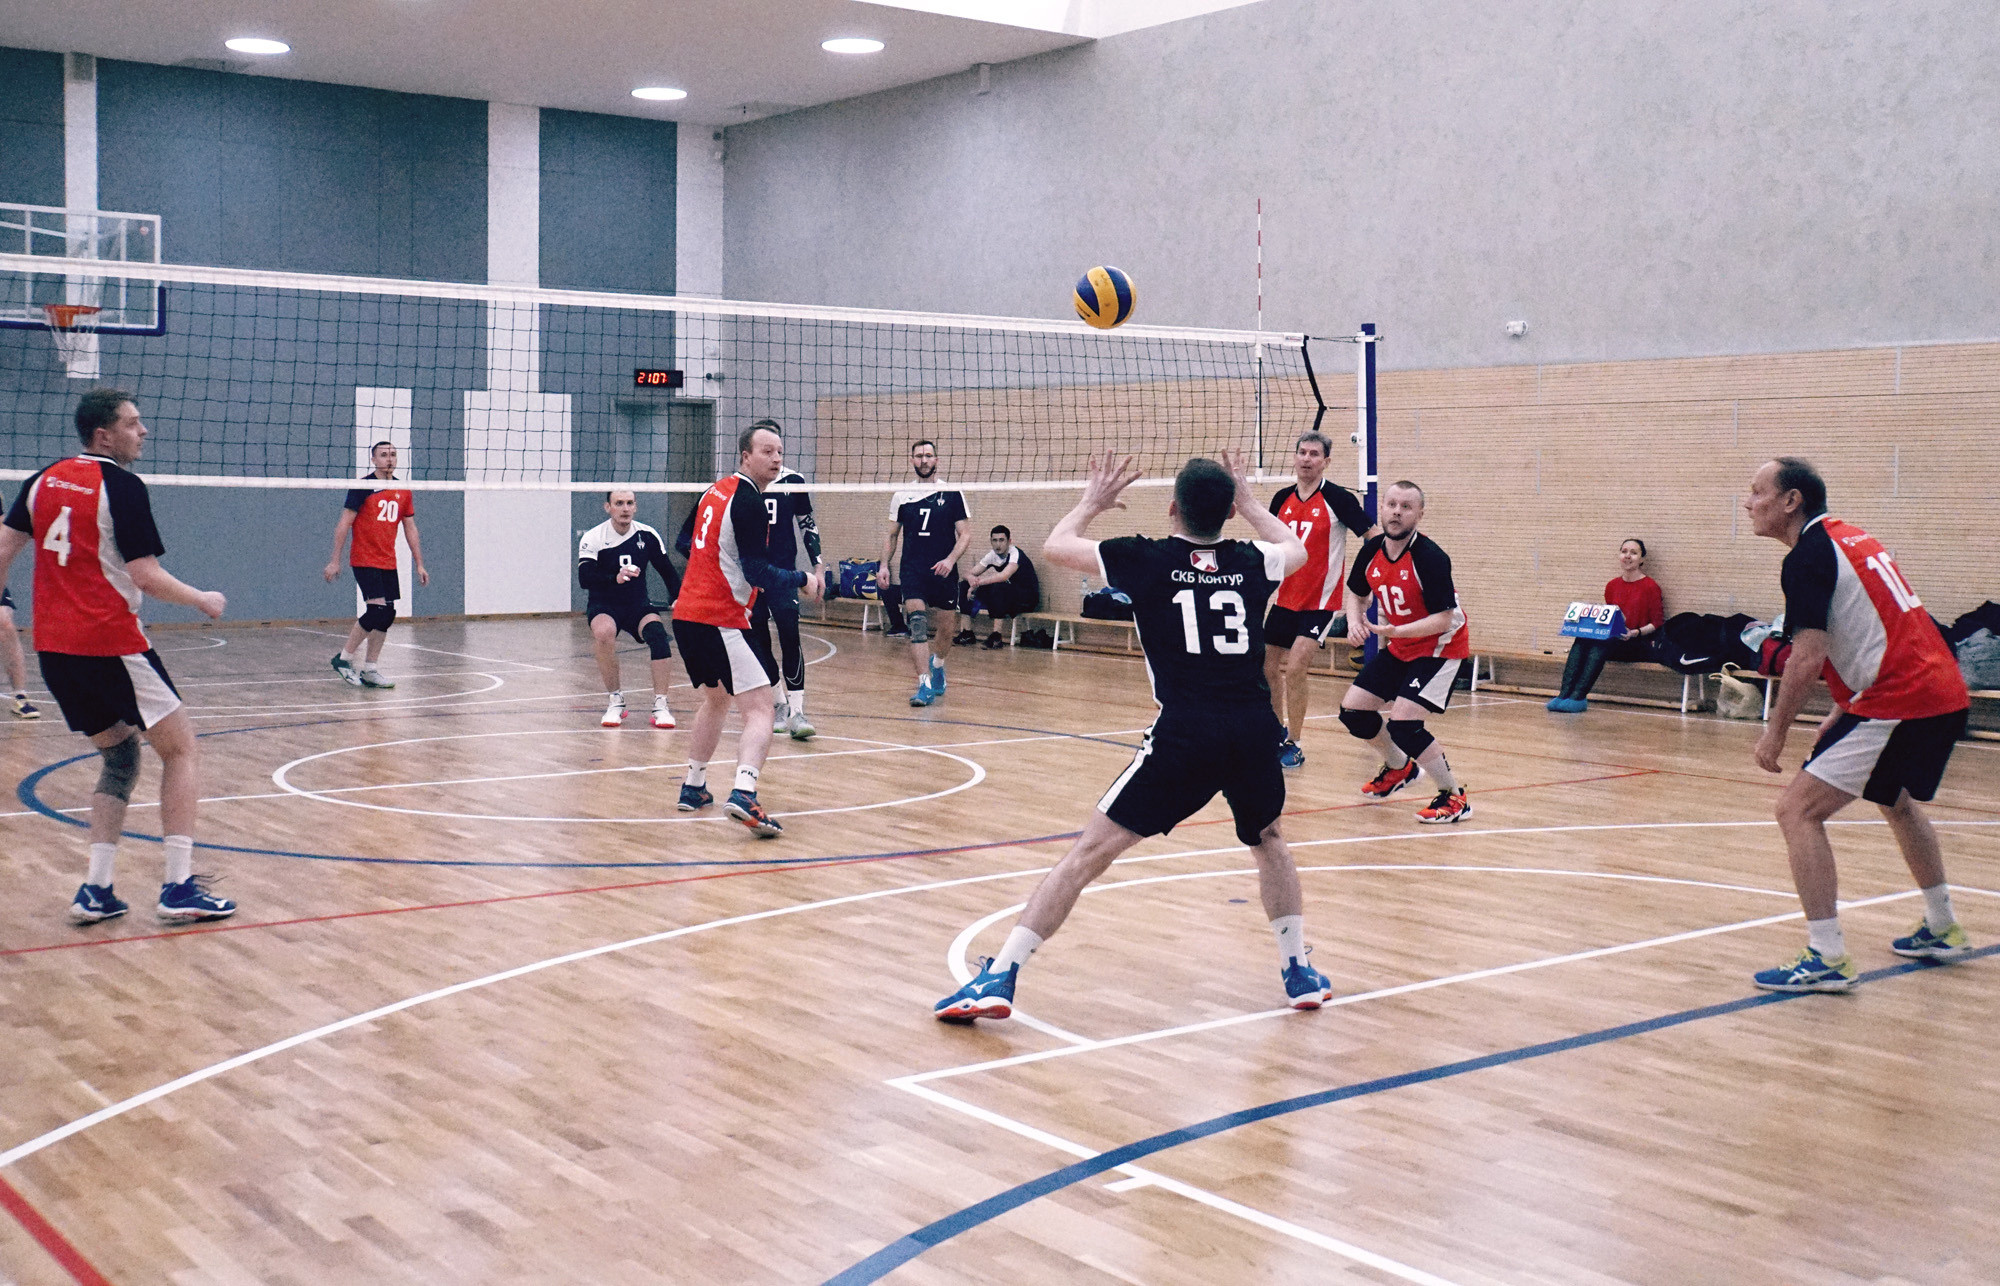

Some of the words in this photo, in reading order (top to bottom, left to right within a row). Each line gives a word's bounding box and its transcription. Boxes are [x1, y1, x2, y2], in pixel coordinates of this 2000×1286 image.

[377, 499, 399, 522] 20
[764, 498, 778, 525] 9
[919, 508, 931, 531] 7
[43, 506, 72, 567] 4
[695, 505, 713, 549] 3
[1171, 570, 1195, 583] СКБ
[1198, 573, 1244, 586] Контур
[1378, 584, 1412, 616] 12
[1568, 606, 1577, 618] 6
[1600, 608, 1610, 621] 8
[1172, 589, 1250, 655] 13
